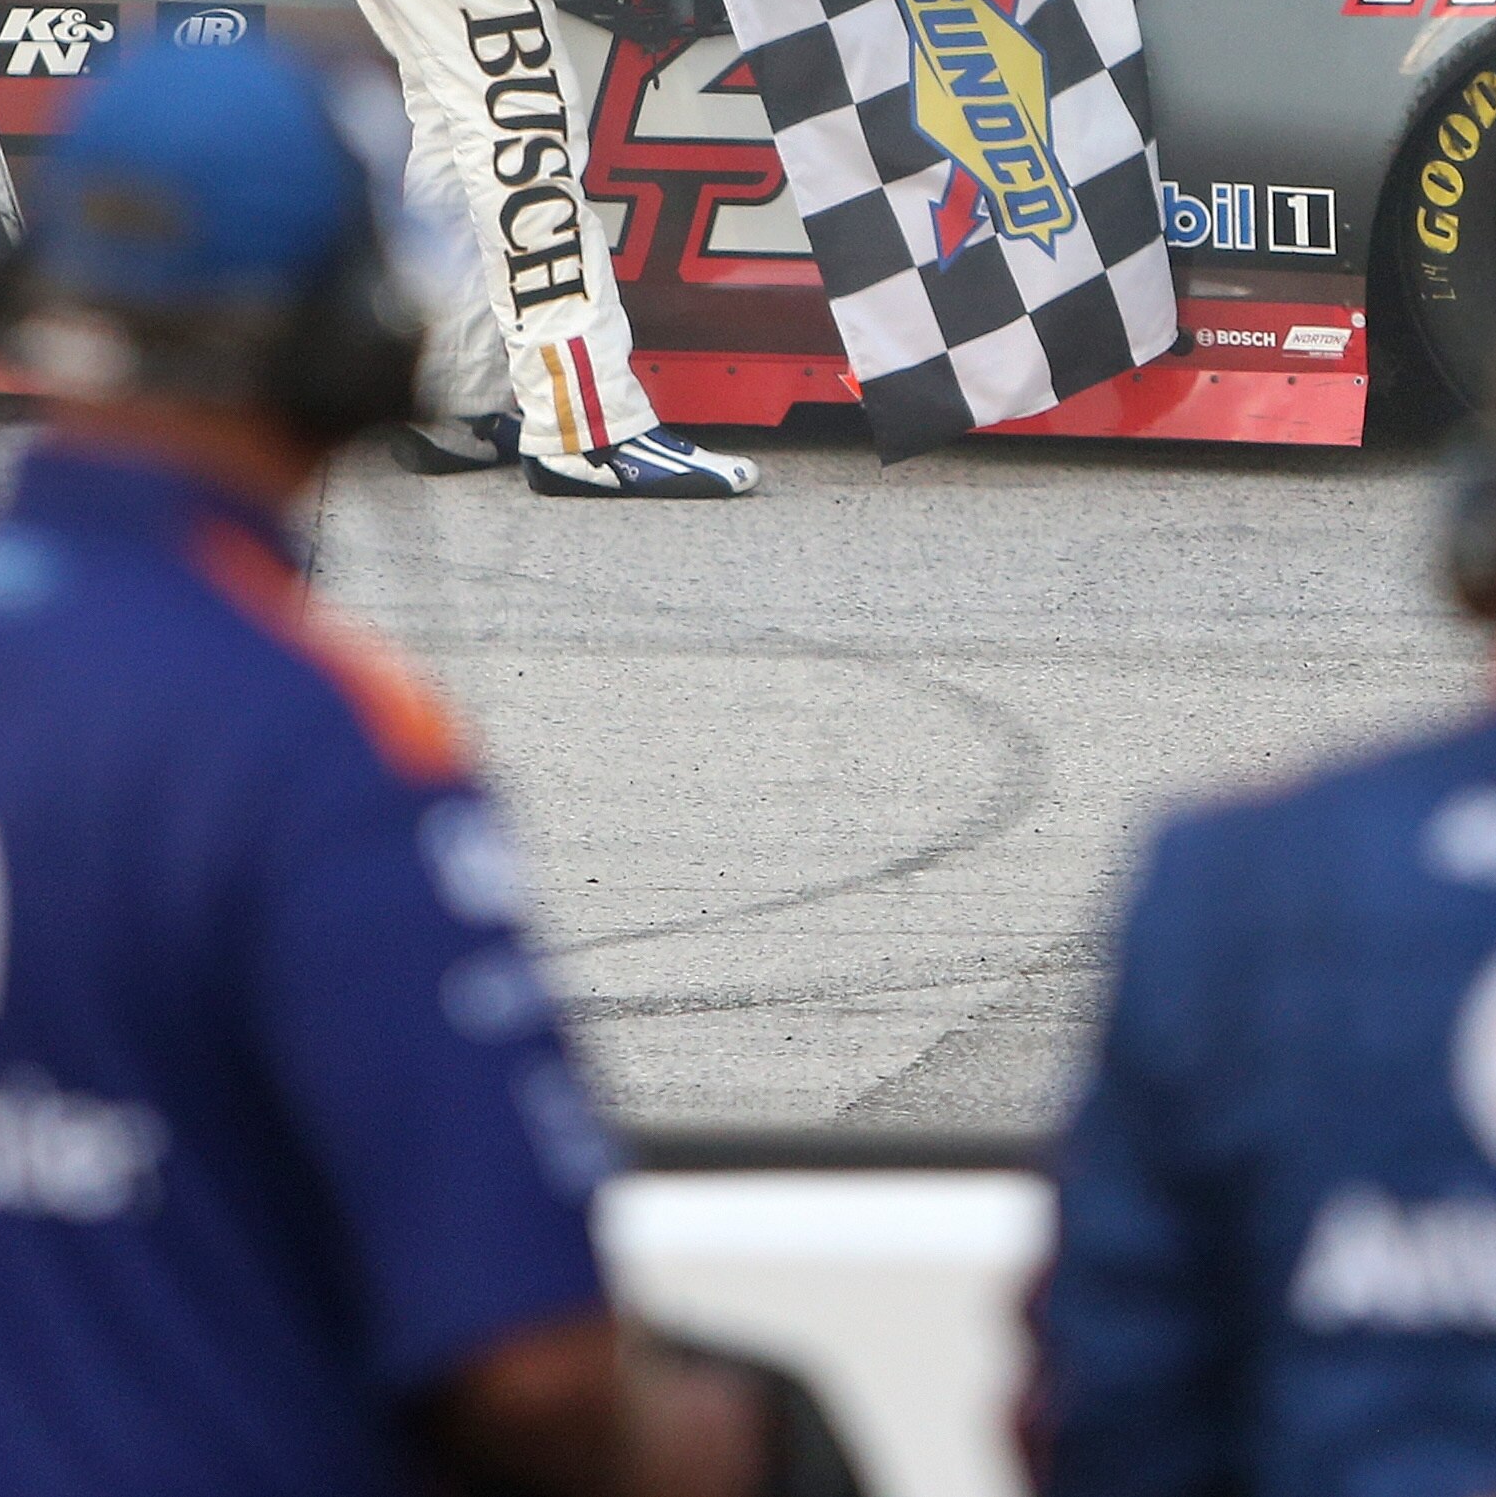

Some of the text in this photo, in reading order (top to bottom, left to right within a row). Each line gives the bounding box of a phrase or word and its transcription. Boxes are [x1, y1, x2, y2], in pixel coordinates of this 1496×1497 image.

[1161, 183, 1255, 250] bil
[1215, 329, 1277, 348] BOSCH
[1291, 332, 1343, 345] NORTON
